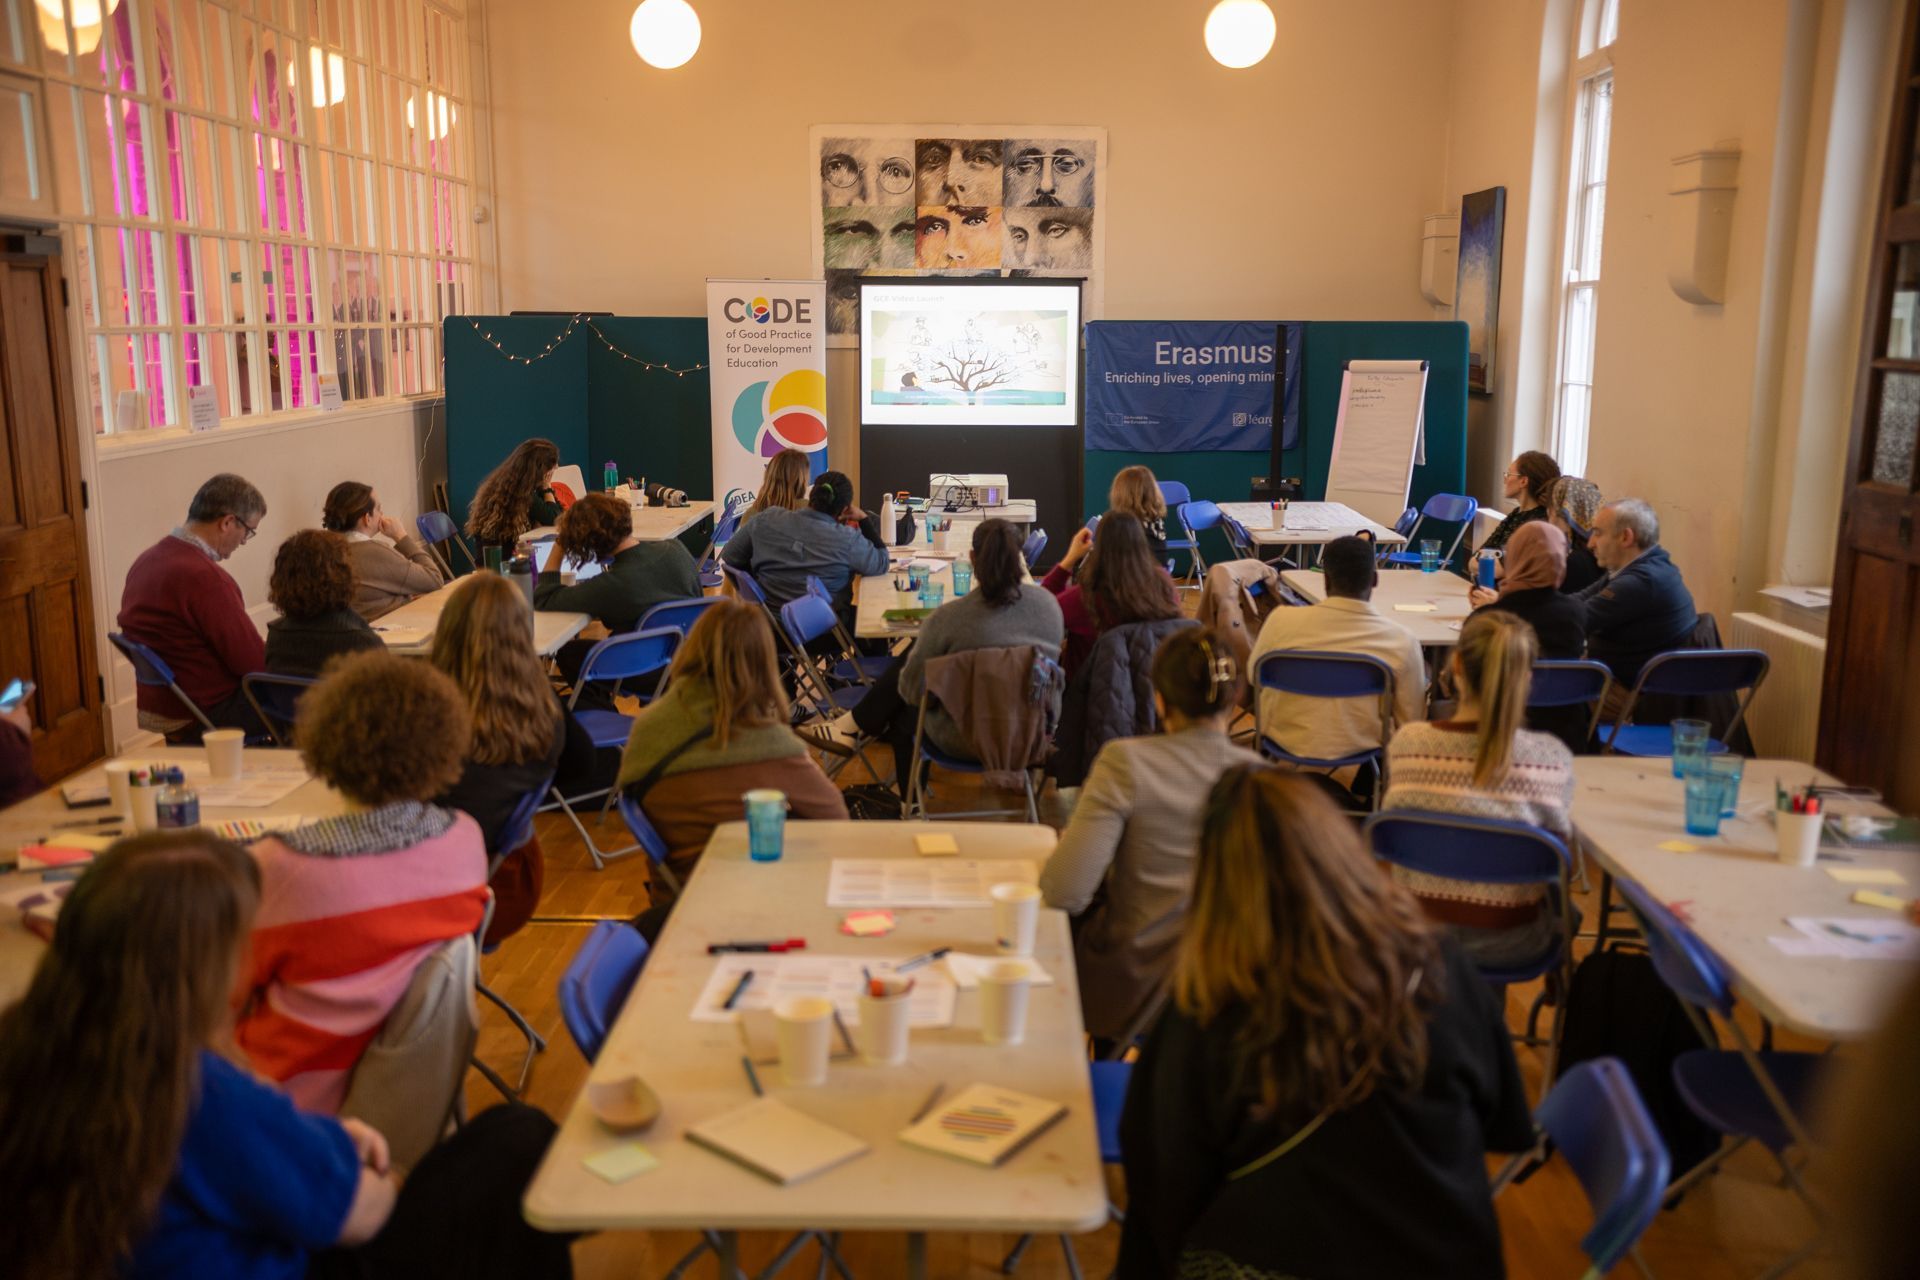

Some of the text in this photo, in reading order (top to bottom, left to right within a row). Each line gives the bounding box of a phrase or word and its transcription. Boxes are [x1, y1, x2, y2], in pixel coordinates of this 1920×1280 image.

[724, 297, 811, 324] CODE
[726, 329, 812, 339] of Good Practice
[727, 343, 812, 355] for Development
[1155, 341, 1290, 365] Erasmus
[727, 358, 778, 368] Education
[1105, 371, 1160, 386] Enriching
[1163, 371, 1194, 385] lives,
[1197, 371, 1245, 385] opening
